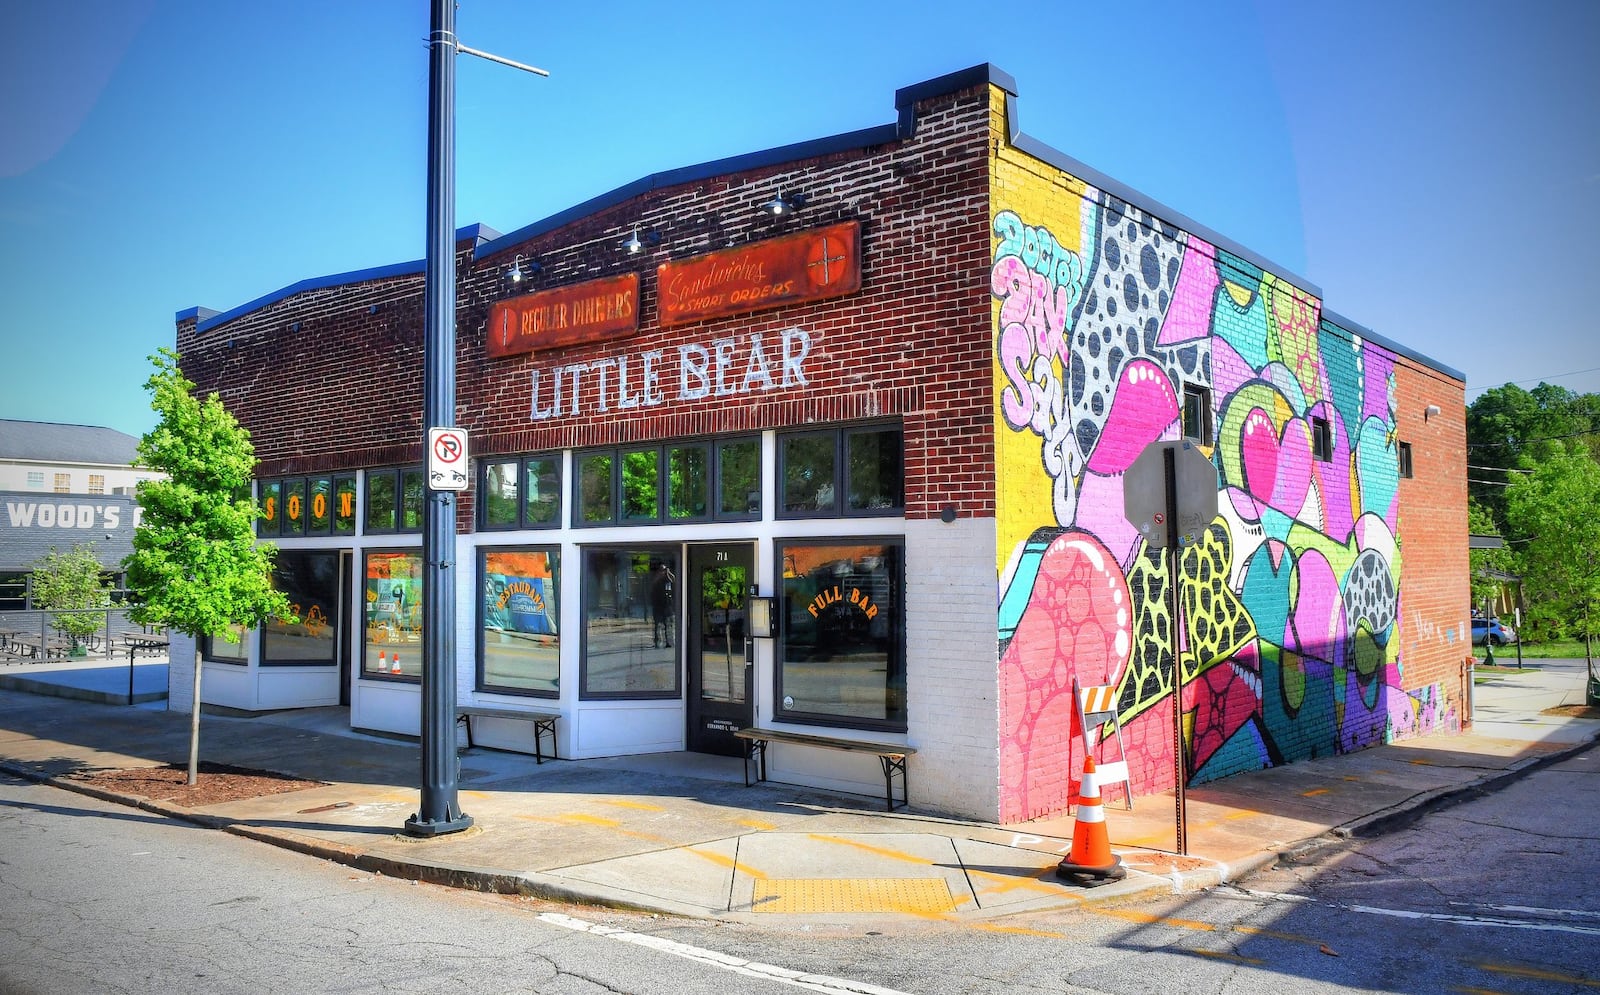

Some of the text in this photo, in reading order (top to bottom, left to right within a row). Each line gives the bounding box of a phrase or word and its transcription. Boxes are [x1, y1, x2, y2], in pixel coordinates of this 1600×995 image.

[667, 254, 767, 312] Sandwiches
[684, 280, 794, 312] SHORT ORDERS
[521, 290, 633, 336] REGULAR DINNERS
[529, 328, 813, 420] LITTLE BEAR
[6, 502, 120, 529] WOOD'S
[266, 493, 352, 520] SOON
[807, 585, 879, 620] FULL BAR
